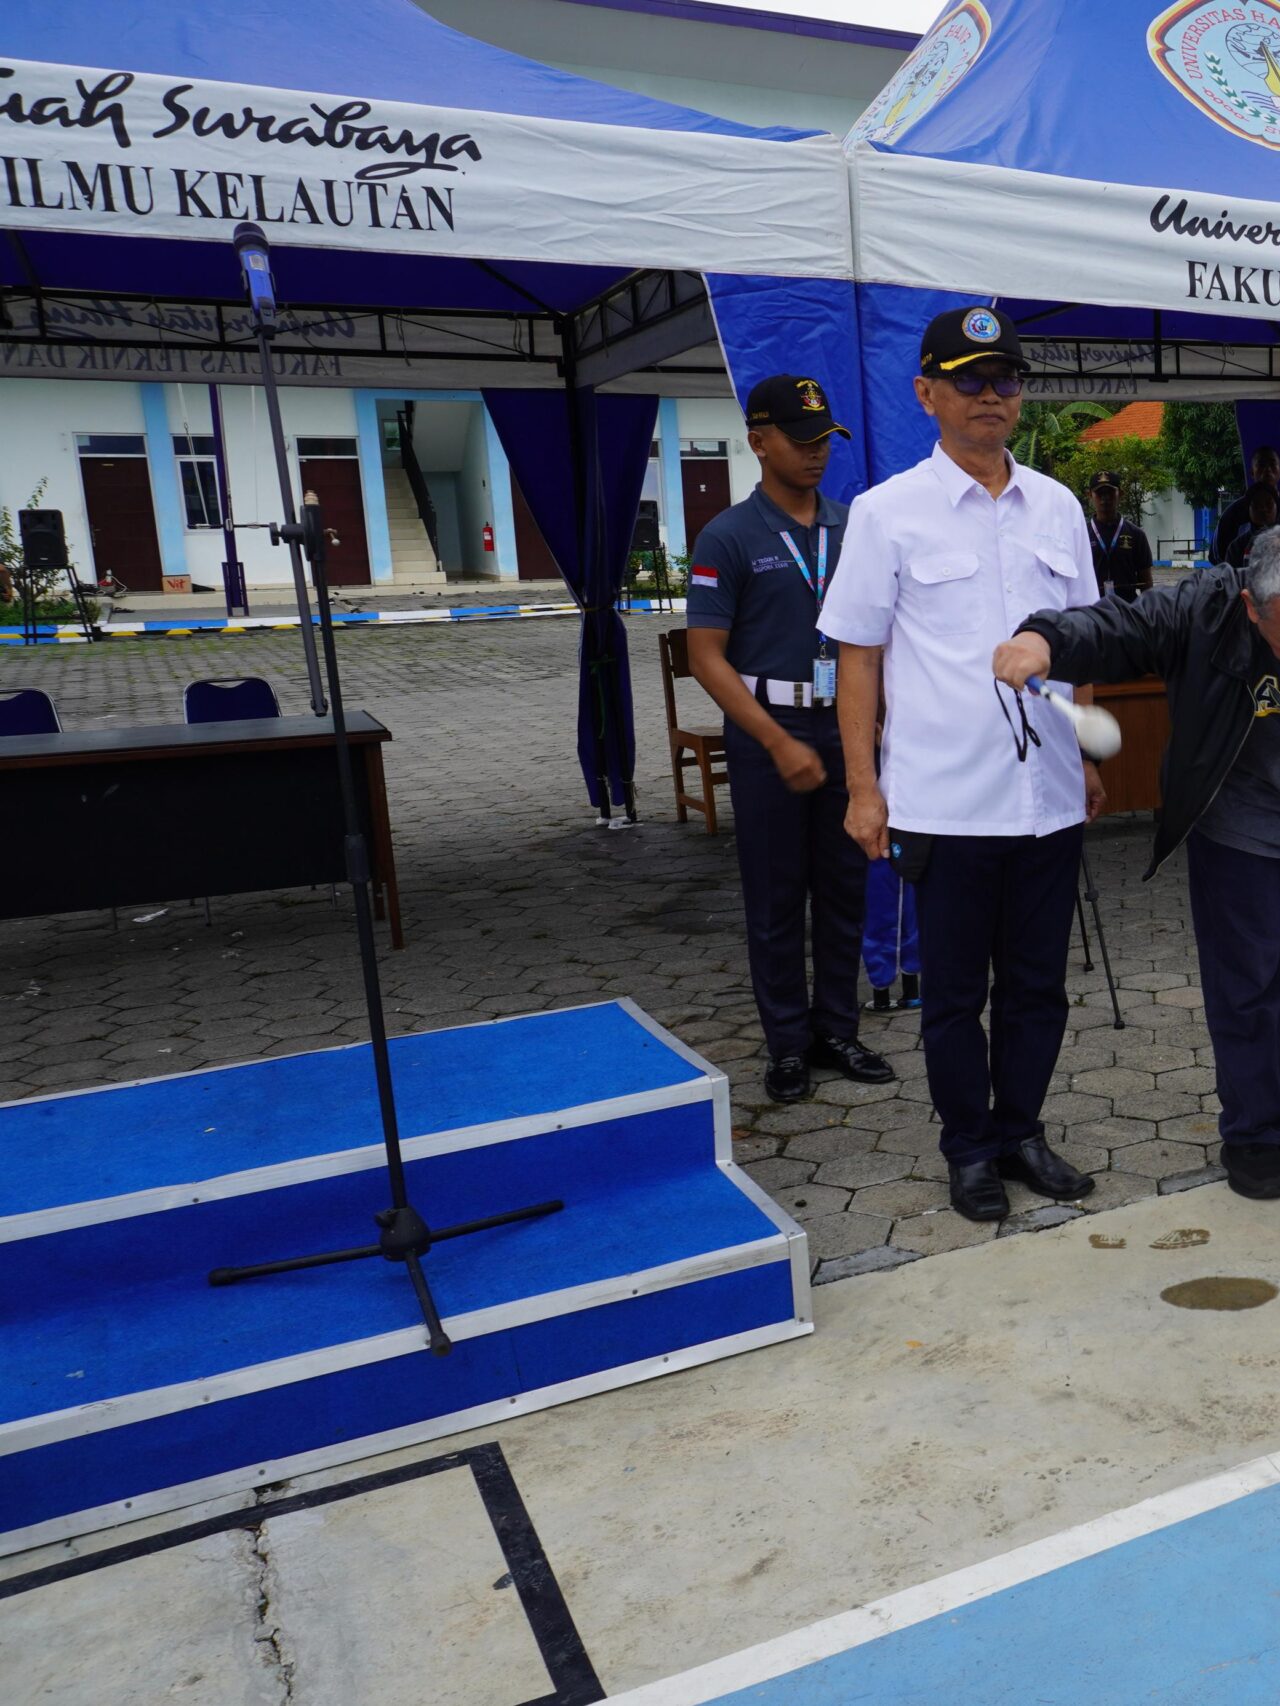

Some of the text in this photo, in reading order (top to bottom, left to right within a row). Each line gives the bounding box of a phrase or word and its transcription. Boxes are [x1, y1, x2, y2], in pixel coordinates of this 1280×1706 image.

[1181, 8, 1246, 80] UNIVERSITAS
[0, 67, 482, 180] uah Surabaya
[1, 156, 455, 232] ILMU KELAUTAN
